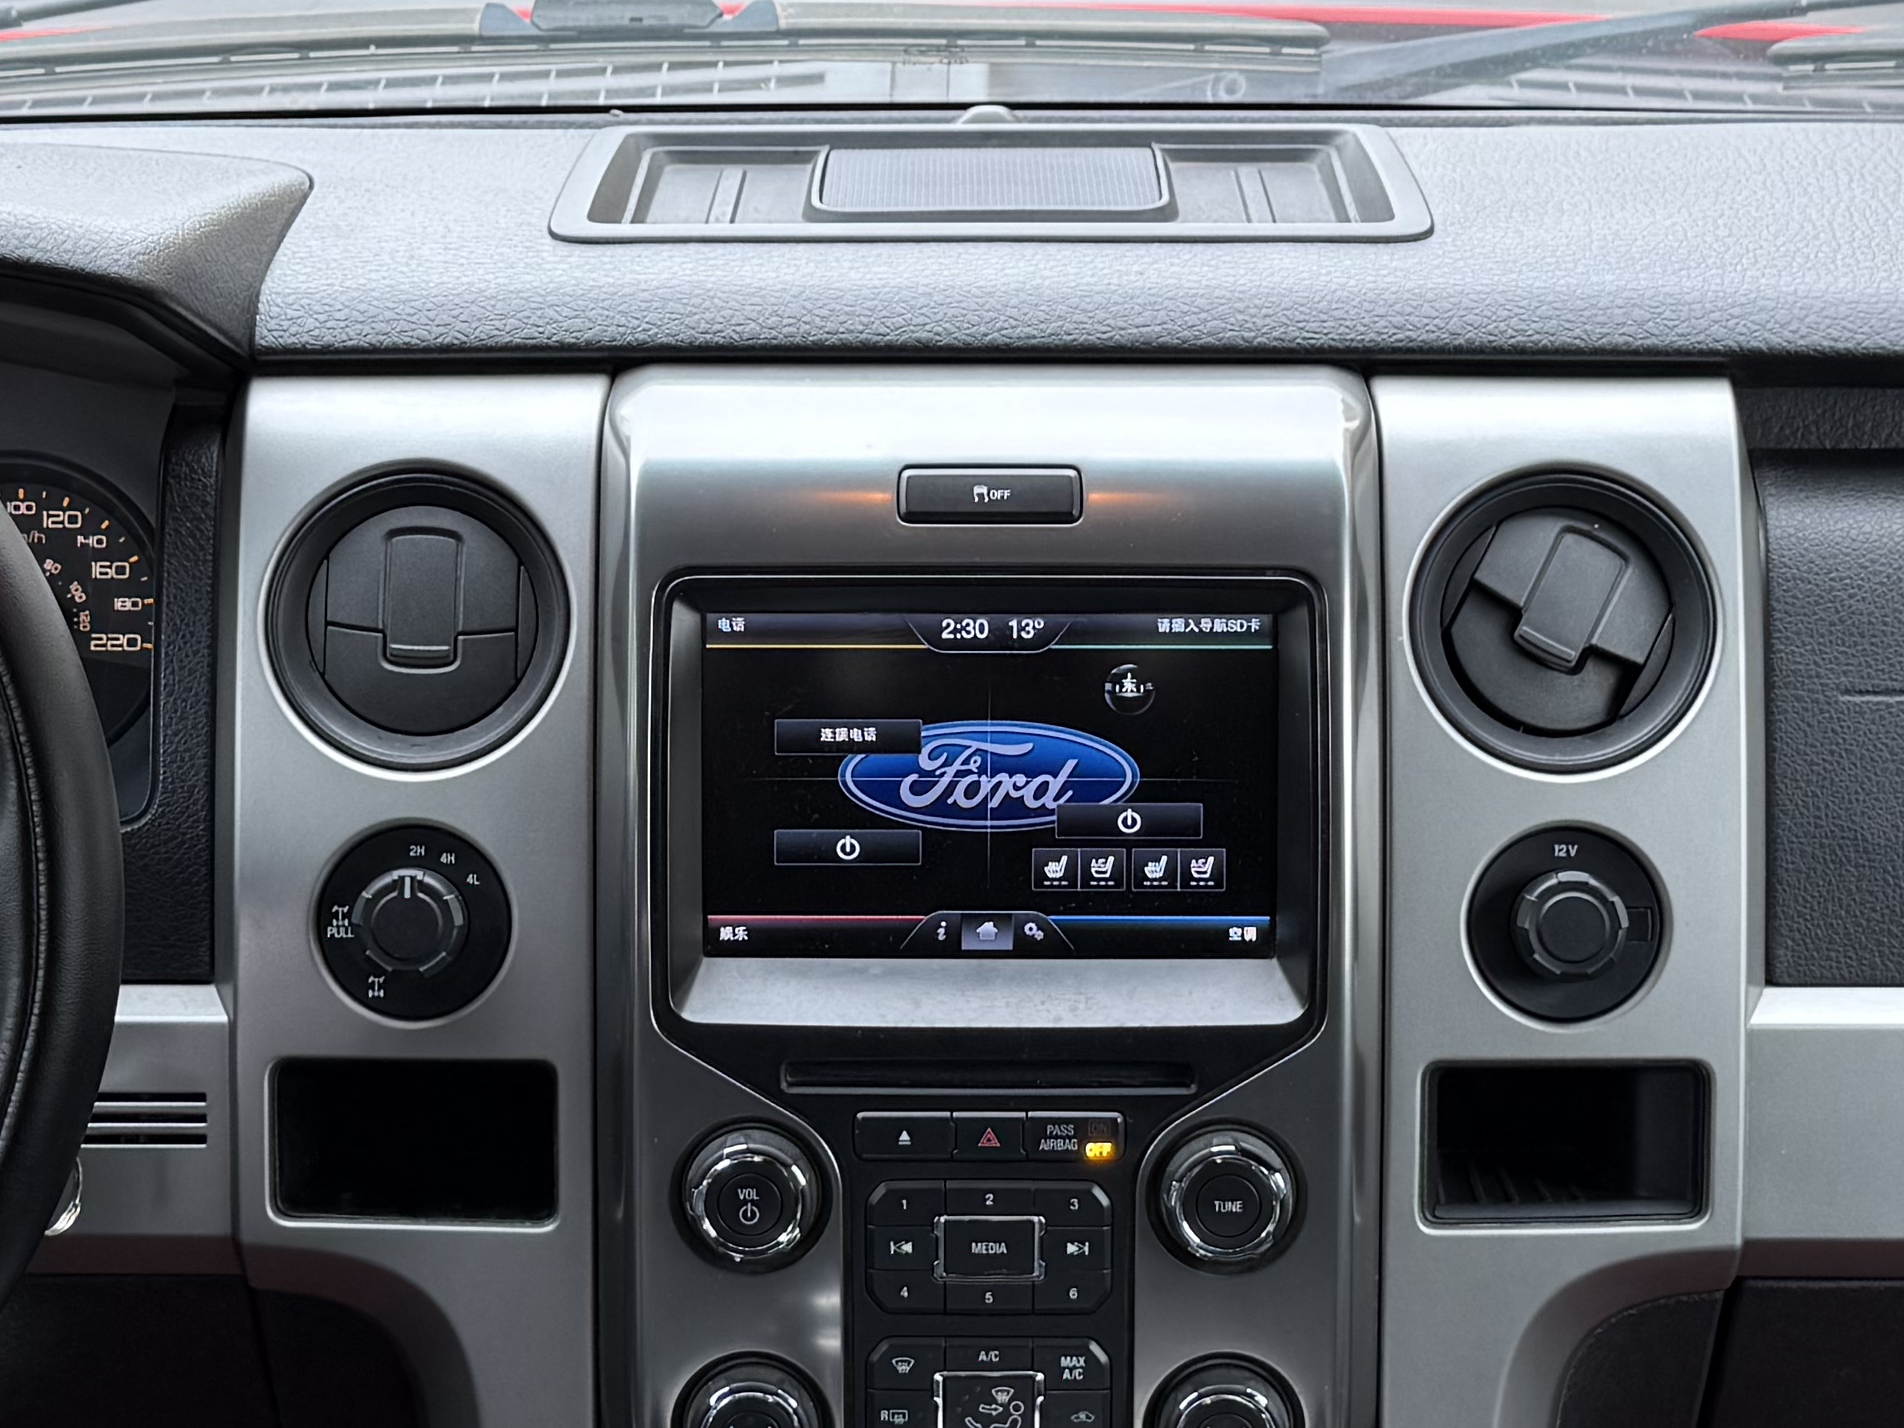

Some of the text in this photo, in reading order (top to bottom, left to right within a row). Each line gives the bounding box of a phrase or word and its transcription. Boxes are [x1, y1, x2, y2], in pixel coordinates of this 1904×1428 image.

[990, 489, 1011, 500] OFF
[6, 501, 36, 515] 100
[42, 511, 82, 529] 120
[77, 535, 107, 548] 140
[43, 559, 62, 574] 80
[91, 562, 130, 579] 160
[114, 598, 142, 611] 180
[717, 617, 745, 632] 电话
[941, 618, 989, 639] 2:30
[90, 634, 142, 651] 220
[899, 738, 1079, 809] Ford
[409, 845, 425, 857] 2H
[440, 852, 455, 864] 4H
[466, 874, 481, 885] 4L
[327, 927, 354, 938] PULL
[1047, 1125, 1074, 1136] PASS
[1039, 1138, 1113, 1157] AIRBAG OFF
[738, 1188, 759, 1200] VOL
[985, 1194, 993, 1206] 2
[901, 1199, 907, 1210] 1
[1070, 1199, 1079, 1210] 3
[1214, 1201, 1243, 1213] TUNE
[971, 1242, 1007, 1255] MEDIA
[900, 1287, 908, 1299] 4
[985, 1292, 993, 1304] 5
[1069, 1288, 1078, 1300] 6
[978, 1351, 1000, 1363] A/C
[1060, 1356, 1086, 1368] MAX
[1062, 1368, 1083, 1381] A/C
